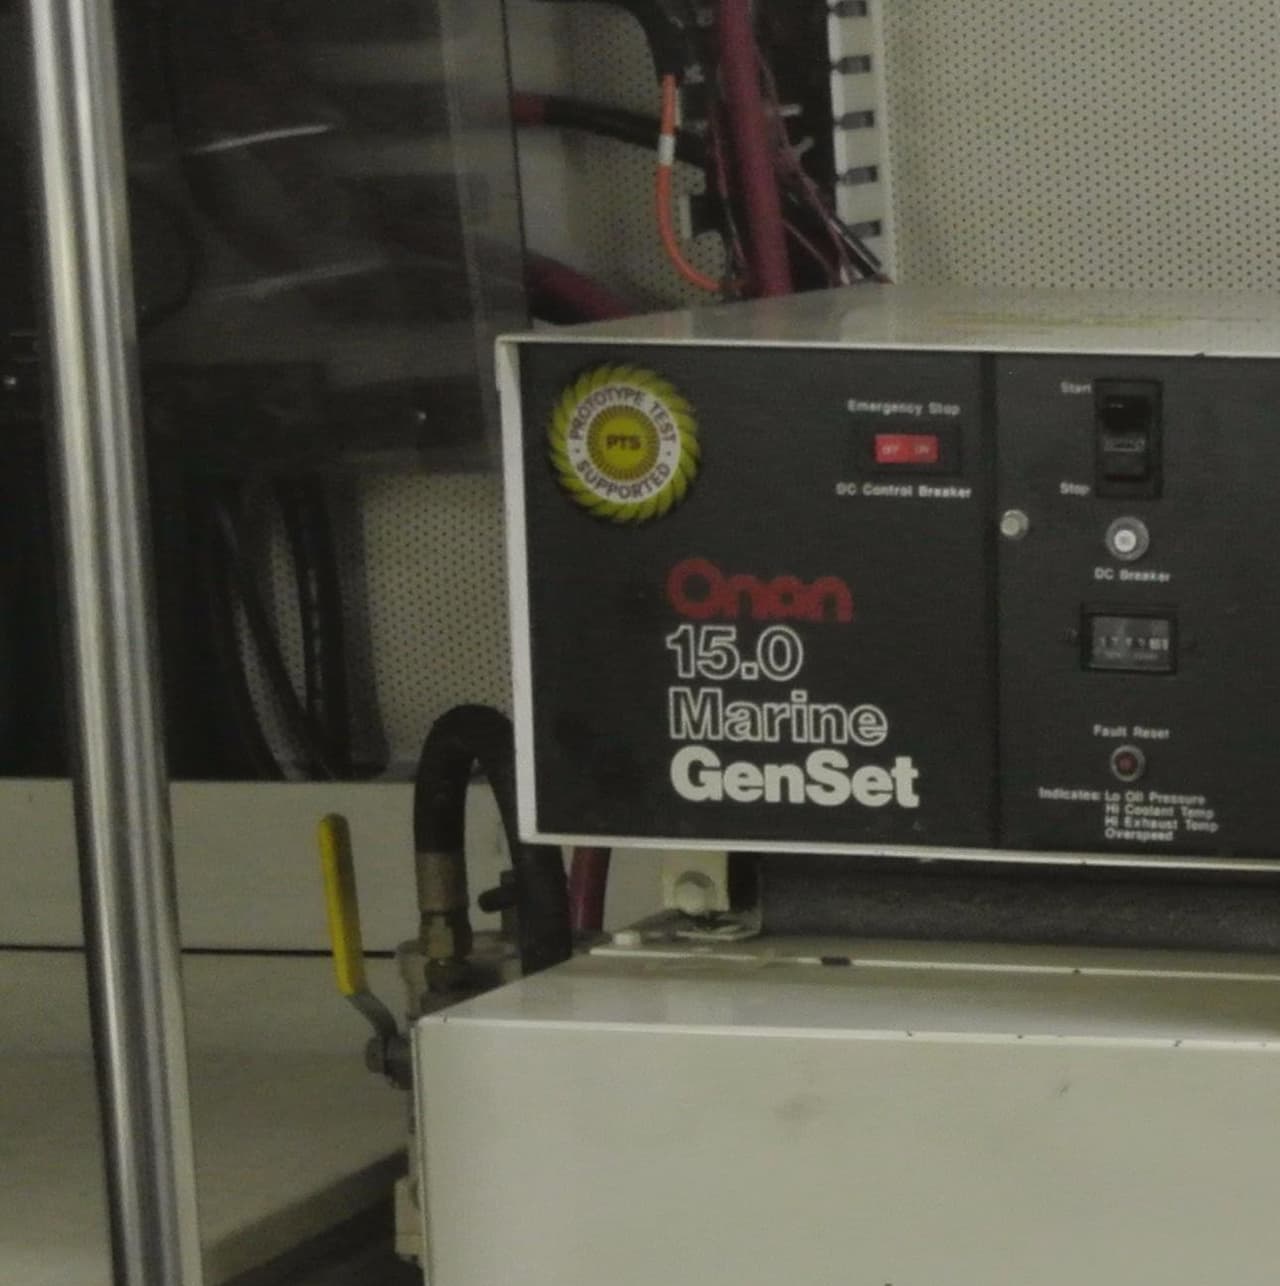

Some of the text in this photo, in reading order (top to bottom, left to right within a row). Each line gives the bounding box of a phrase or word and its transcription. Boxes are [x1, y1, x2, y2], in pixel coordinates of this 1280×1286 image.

[1060, 381, 1092, 394] Start
[569, 386, 678, 443] PROTOTYPE TEST
[847, 398, 961, 416] Emergency Stop
[606, 434, 641, 450] PTS
[577, 460, 670, 499] SUPPORTED
[835, 482, 972, 499] DC Control Breaker
[1060, 482, 1090, 496] Stop
[1094, 567, 1170, 583] DC Breaker
[667, 558, 854, 623] Onan
[665, 623, 804, 682] 15.0
[668, 685, 889, 747] Marine
[1093, 723, 1170, 740] Fault Reset
[669, 744, 920, 808] GenSet
[1104, 790, 1121, 803] Lo
[1148, 790, 1206, 806] Pressure
[1124, 803, 1175, 817] Coolant
[1181, 805, 1215, 820] Temp
[1124, 815, 1178, 831] Exhaust
[1185, 818, 1220, 832] Temp
[1104, 826, 1174, 843] Overspeed
